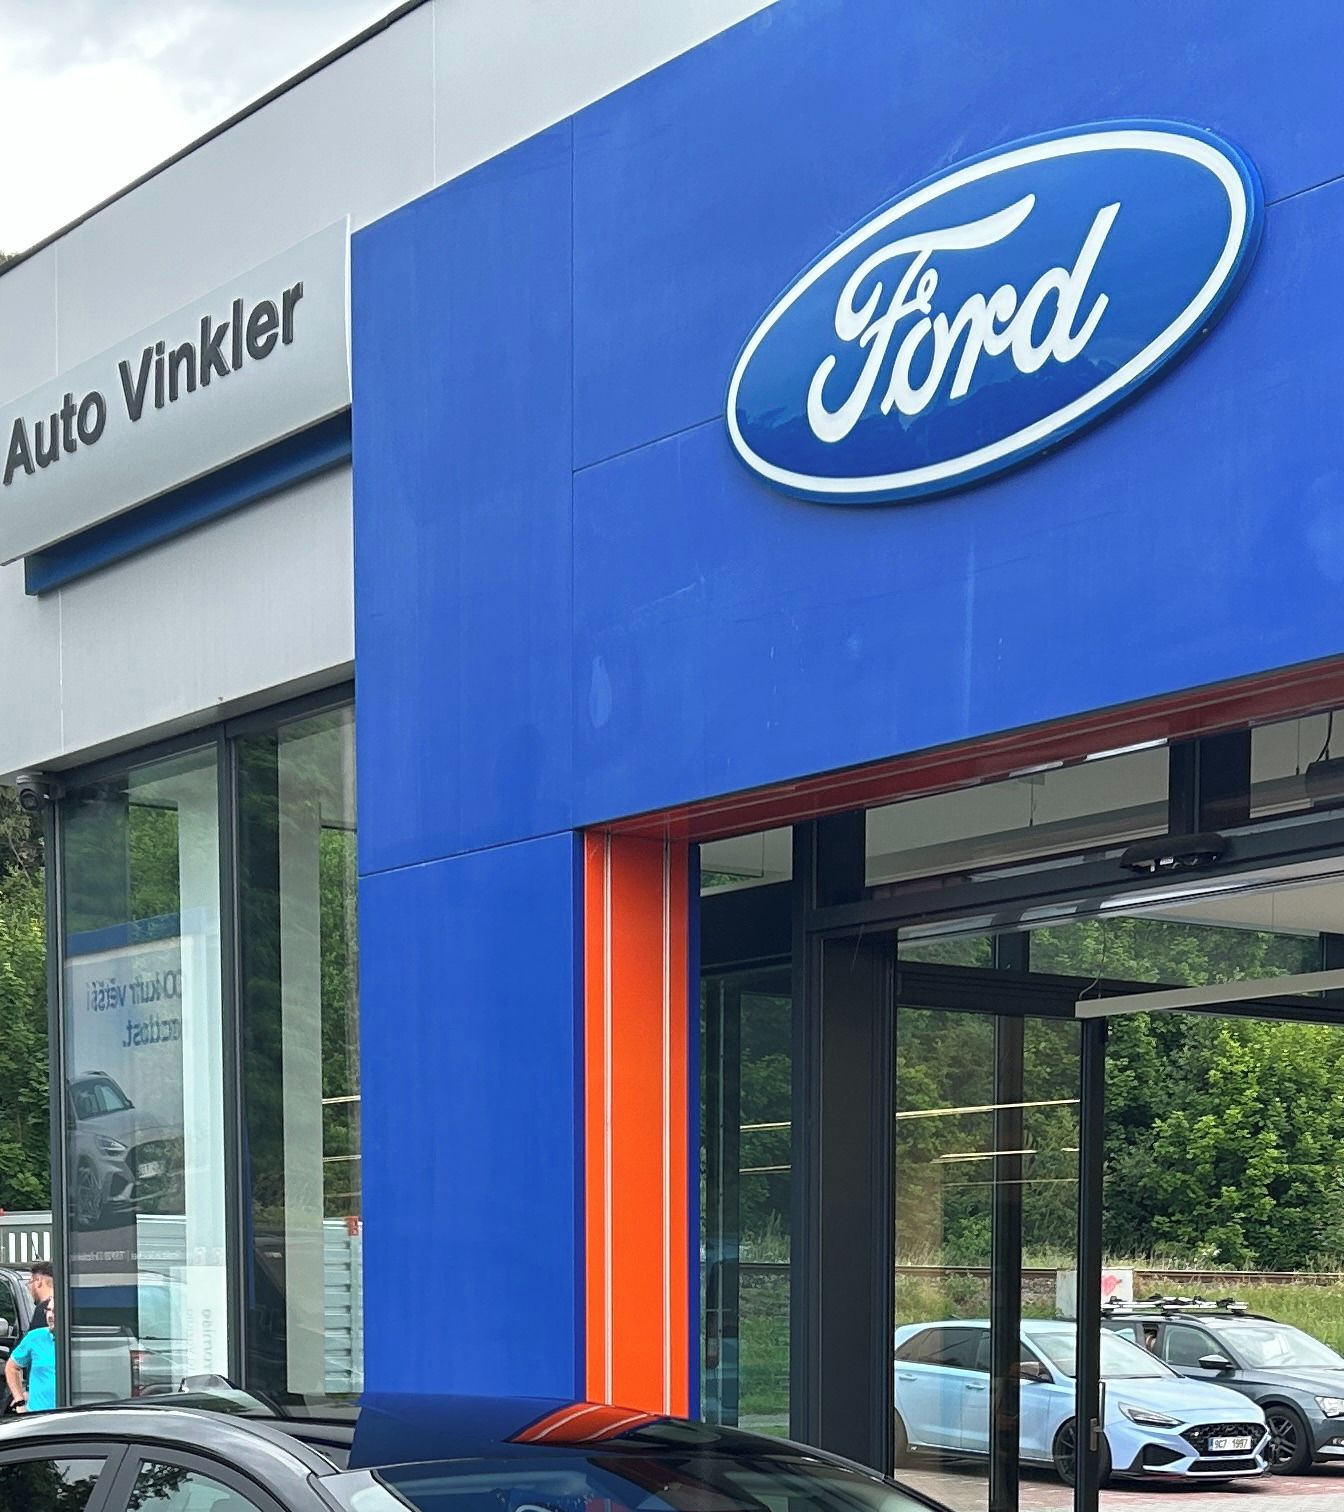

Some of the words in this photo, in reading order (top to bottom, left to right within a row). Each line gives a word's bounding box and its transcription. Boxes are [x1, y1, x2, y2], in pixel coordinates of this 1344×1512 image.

[2, 390, 107, 486] Auto
[118, 281, 304, 422] Vinkler
[807, 193, 1121, 443] Ford
